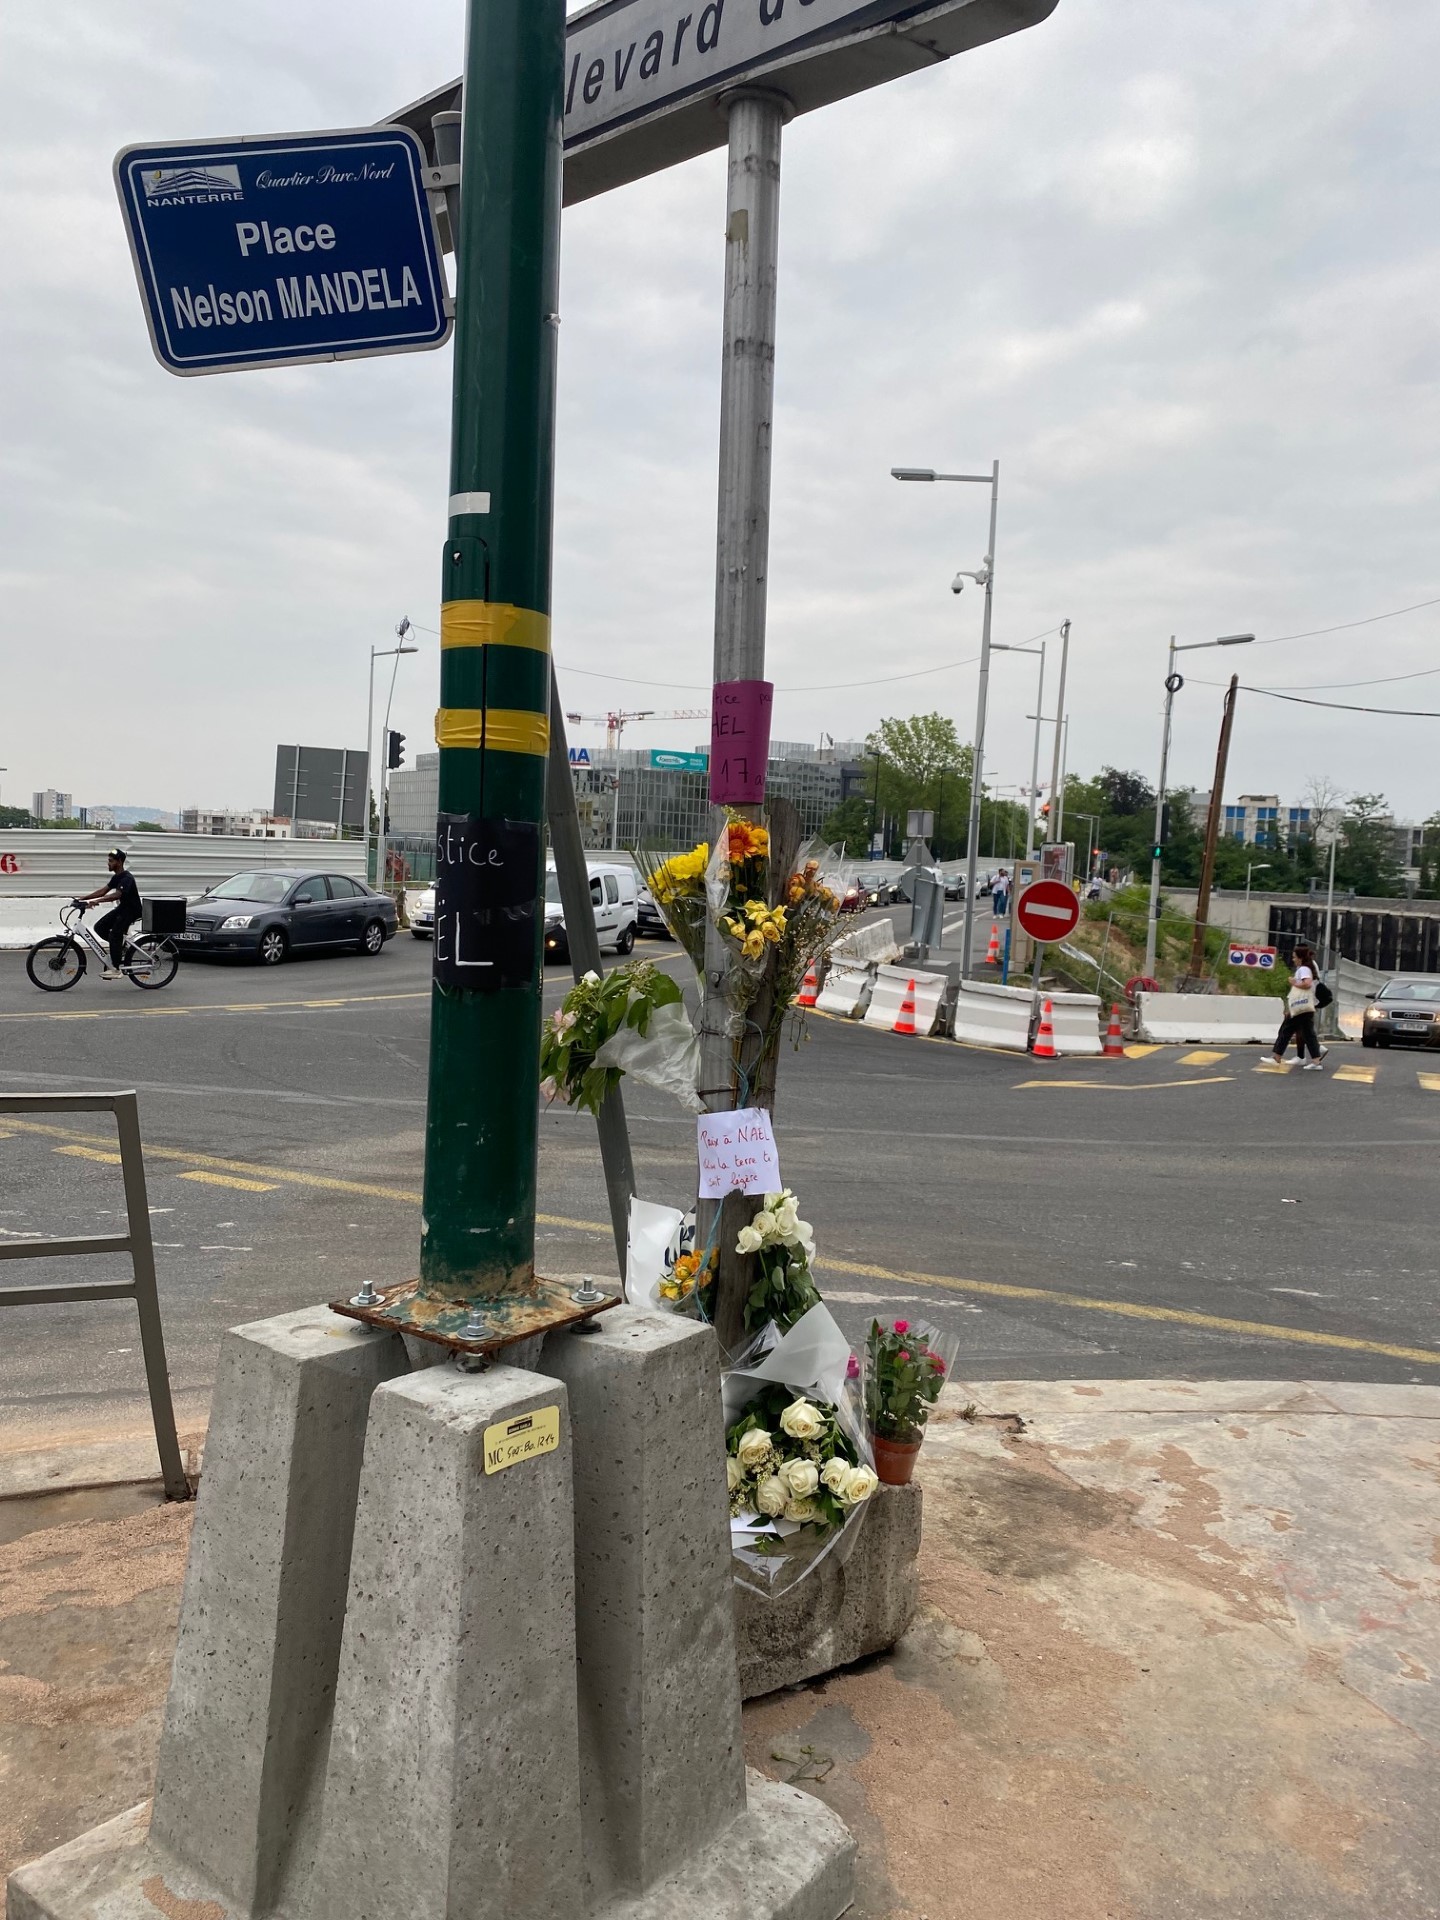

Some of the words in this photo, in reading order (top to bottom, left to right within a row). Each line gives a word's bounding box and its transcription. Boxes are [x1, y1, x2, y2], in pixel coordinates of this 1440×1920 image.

[255, 170, 314, 189] Quartier
[315, 165, 354, 184] Parc
[354, 162, 395, 182] Nord
[147, 191, 244, 208] NANTERRE
[235, 221, 337, 257] Place
[170, 284, 273, 330] Nelson
[275, 265, 423, 320] MANDELA
[721, 757, 749, 784] 17
[701, 1130, 719, 1149] Paix
[718, 1157, 730, 1170] la
[734, 1154, 757, 1168] terre
[488, 1447, 504, 1468] MC
